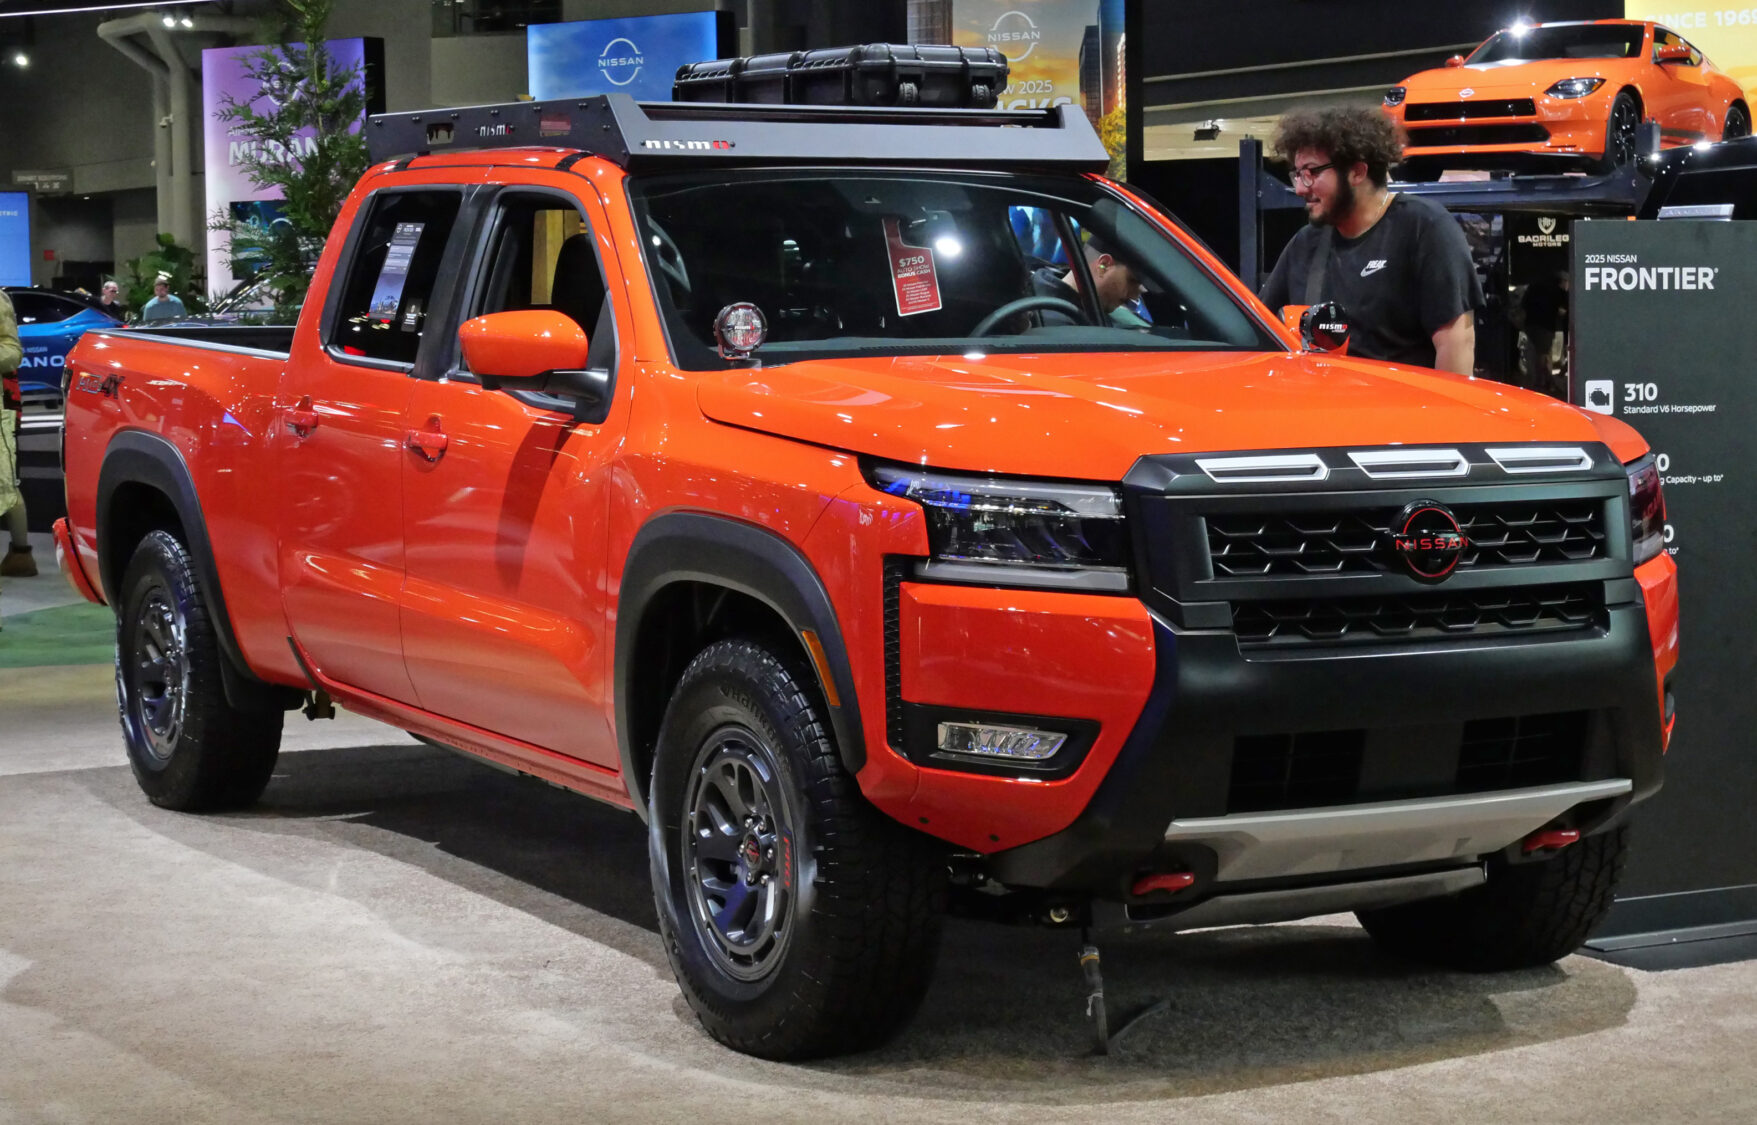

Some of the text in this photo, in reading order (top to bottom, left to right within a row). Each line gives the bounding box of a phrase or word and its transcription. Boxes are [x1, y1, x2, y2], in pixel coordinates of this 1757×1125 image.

[988, 31, 1040, 42] NISSAN
[598, 56, 644, 67] NISSAN
[1019, 79, 1053, 95] 2025
[229, 136, 328, 166] MURAN
[1518, 234, 1570, 243] SACRILEG
[899, 256, 925, 267] $750
[1585, 254, 1638, 264] 2025 NISSAN
[1585, 267, 1715, 290] FRONTIER
[17, 355, 66, 369] ANO
[1623, 382, 1659, 402] 310
[1623, 404, 1717, 415] Standard V6 Horsepower
[1665, 475, 1697, 485] Capacity
[1702, 475, 1714, 483] up
[1395, 536, 1469, 551] NISSAN
